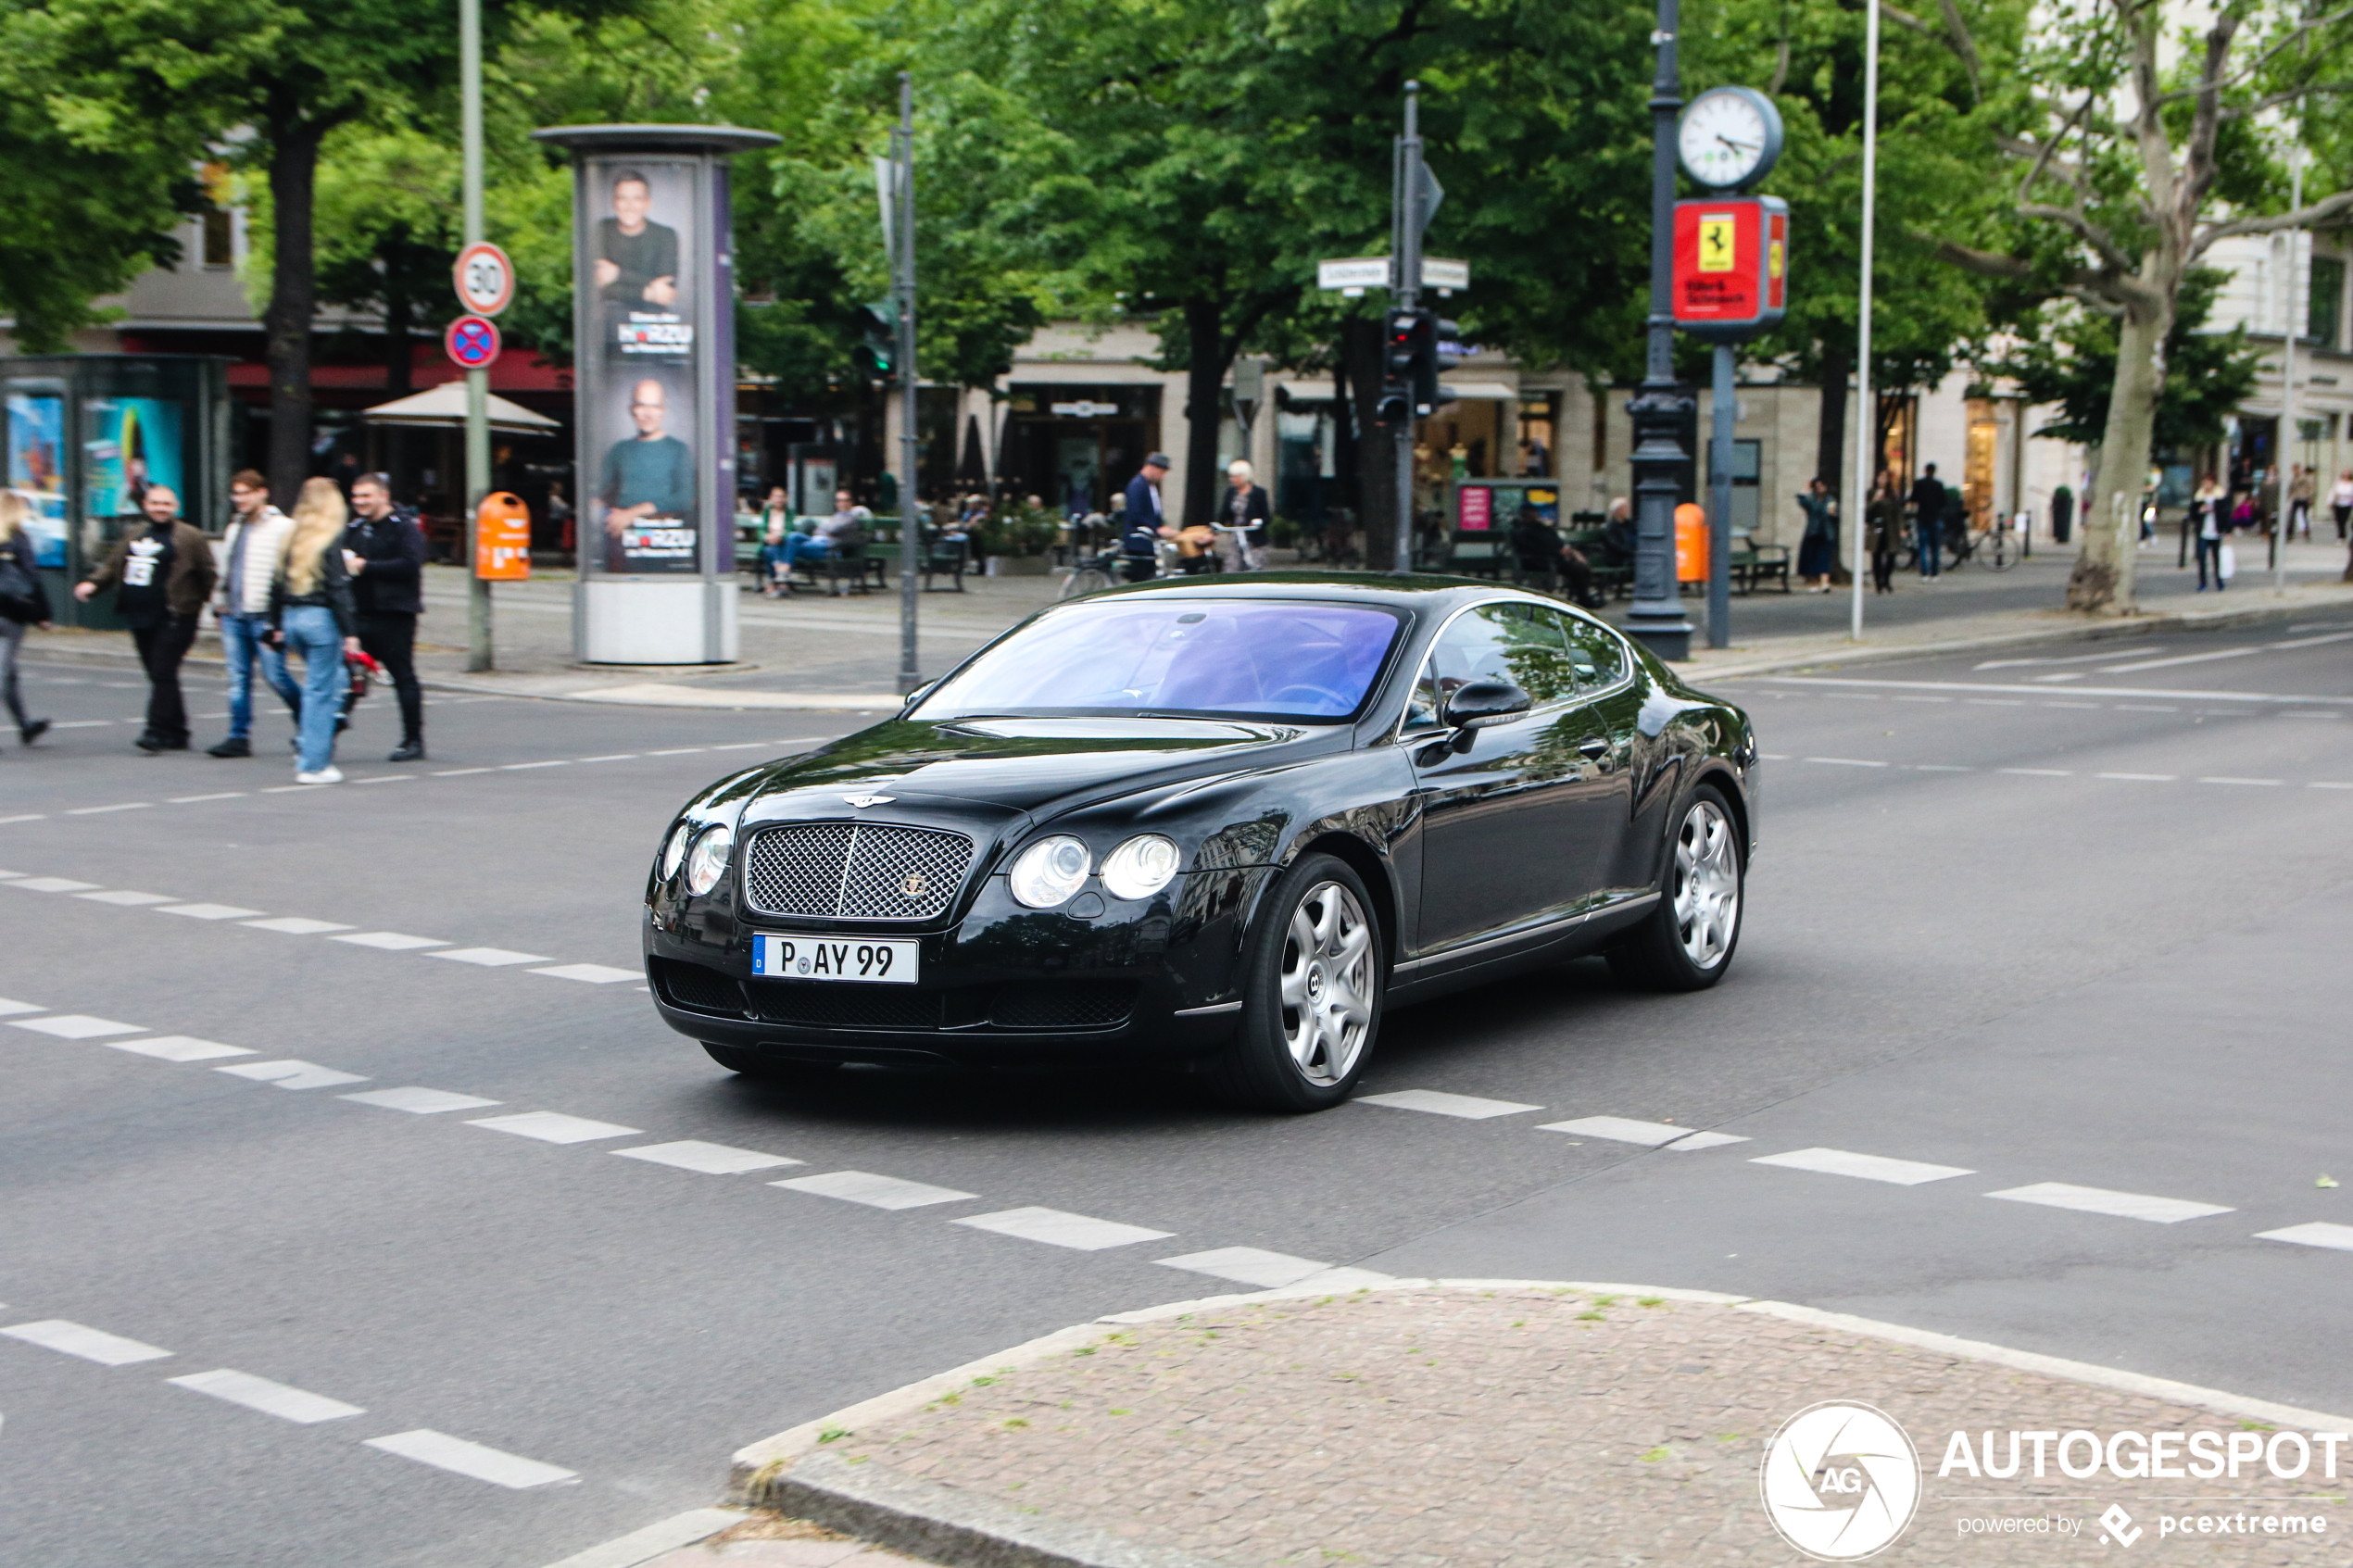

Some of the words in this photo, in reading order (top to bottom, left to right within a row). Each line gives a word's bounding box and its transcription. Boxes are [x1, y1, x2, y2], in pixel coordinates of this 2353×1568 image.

[468, 262, 501, 294] 30
[755, 959, 761, 969] D
[781, 941, 795, 972] P
[813, 943, 849, 974] AY
[857, 945, 893, 976] 99
